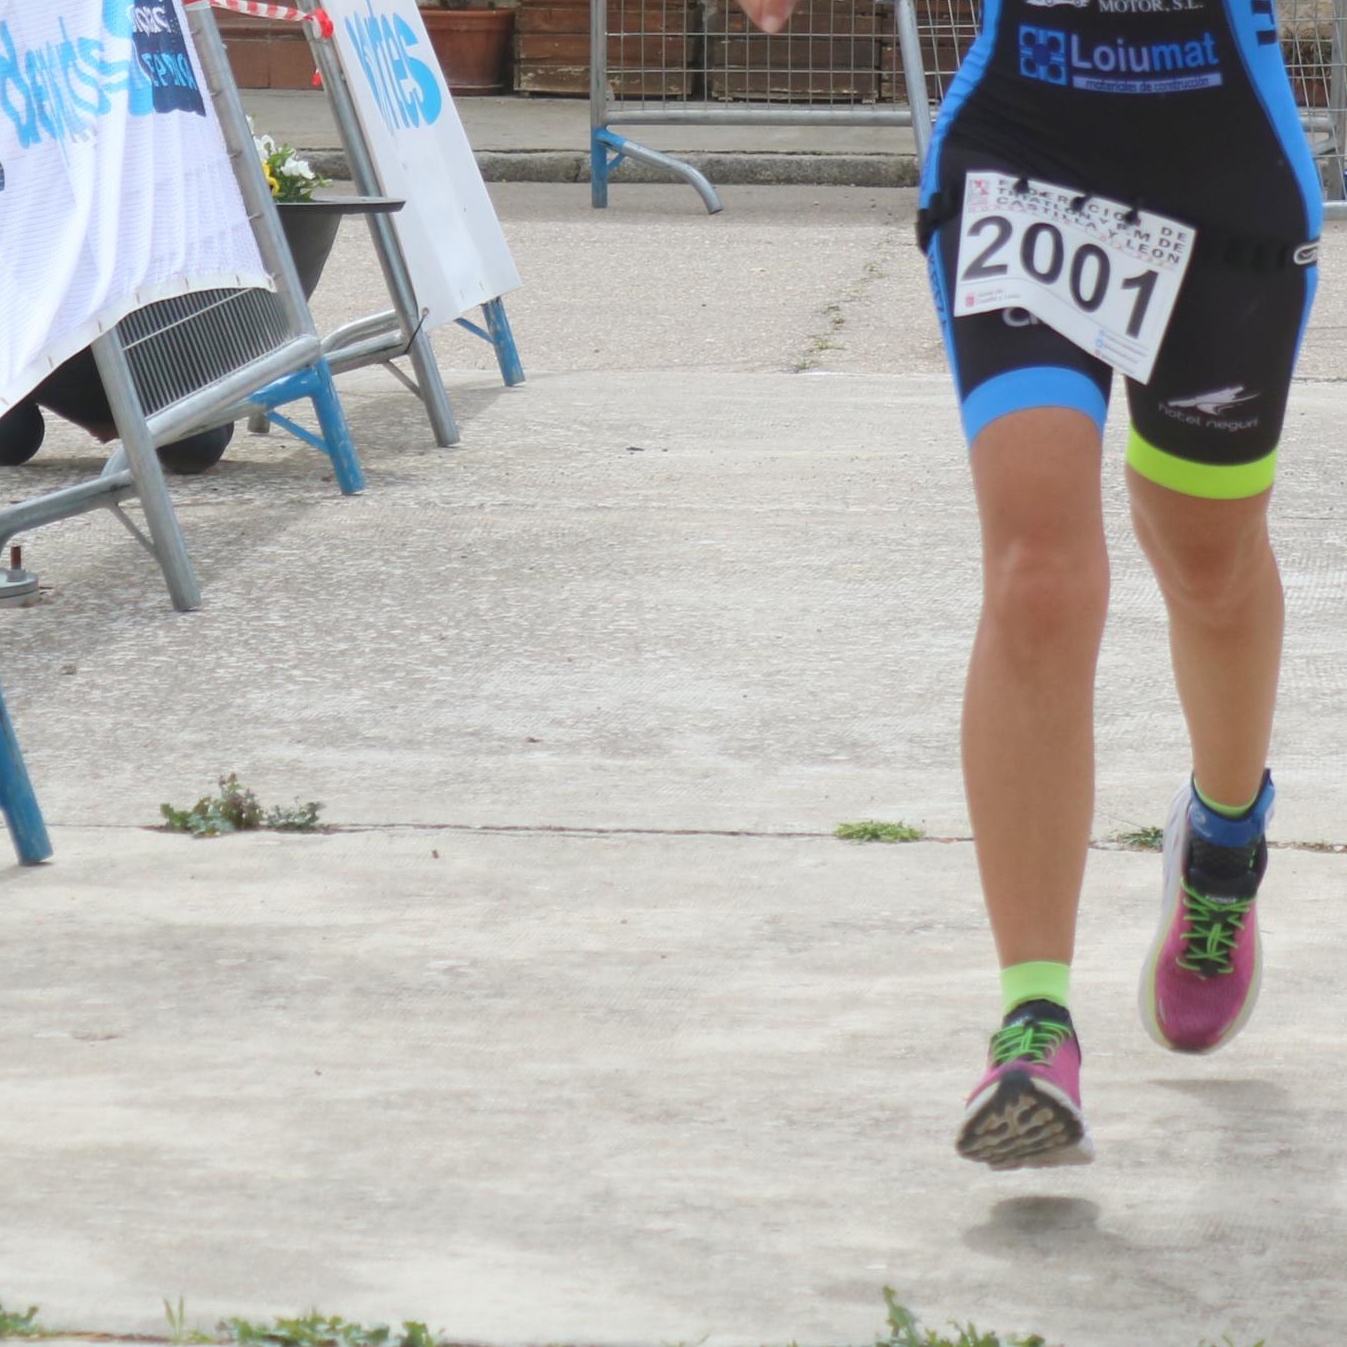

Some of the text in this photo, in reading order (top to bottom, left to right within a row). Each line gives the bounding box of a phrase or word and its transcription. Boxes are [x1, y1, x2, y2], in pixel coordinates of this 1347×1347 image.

[1070, 32, 1219, 73] Loiumat
[1158, 237, 1185, 253] DE
[1160, 226, 1188, 242] DE
[1126, 238, 1181, 265] LEON
[960, 215, 1160, 340] 2001
